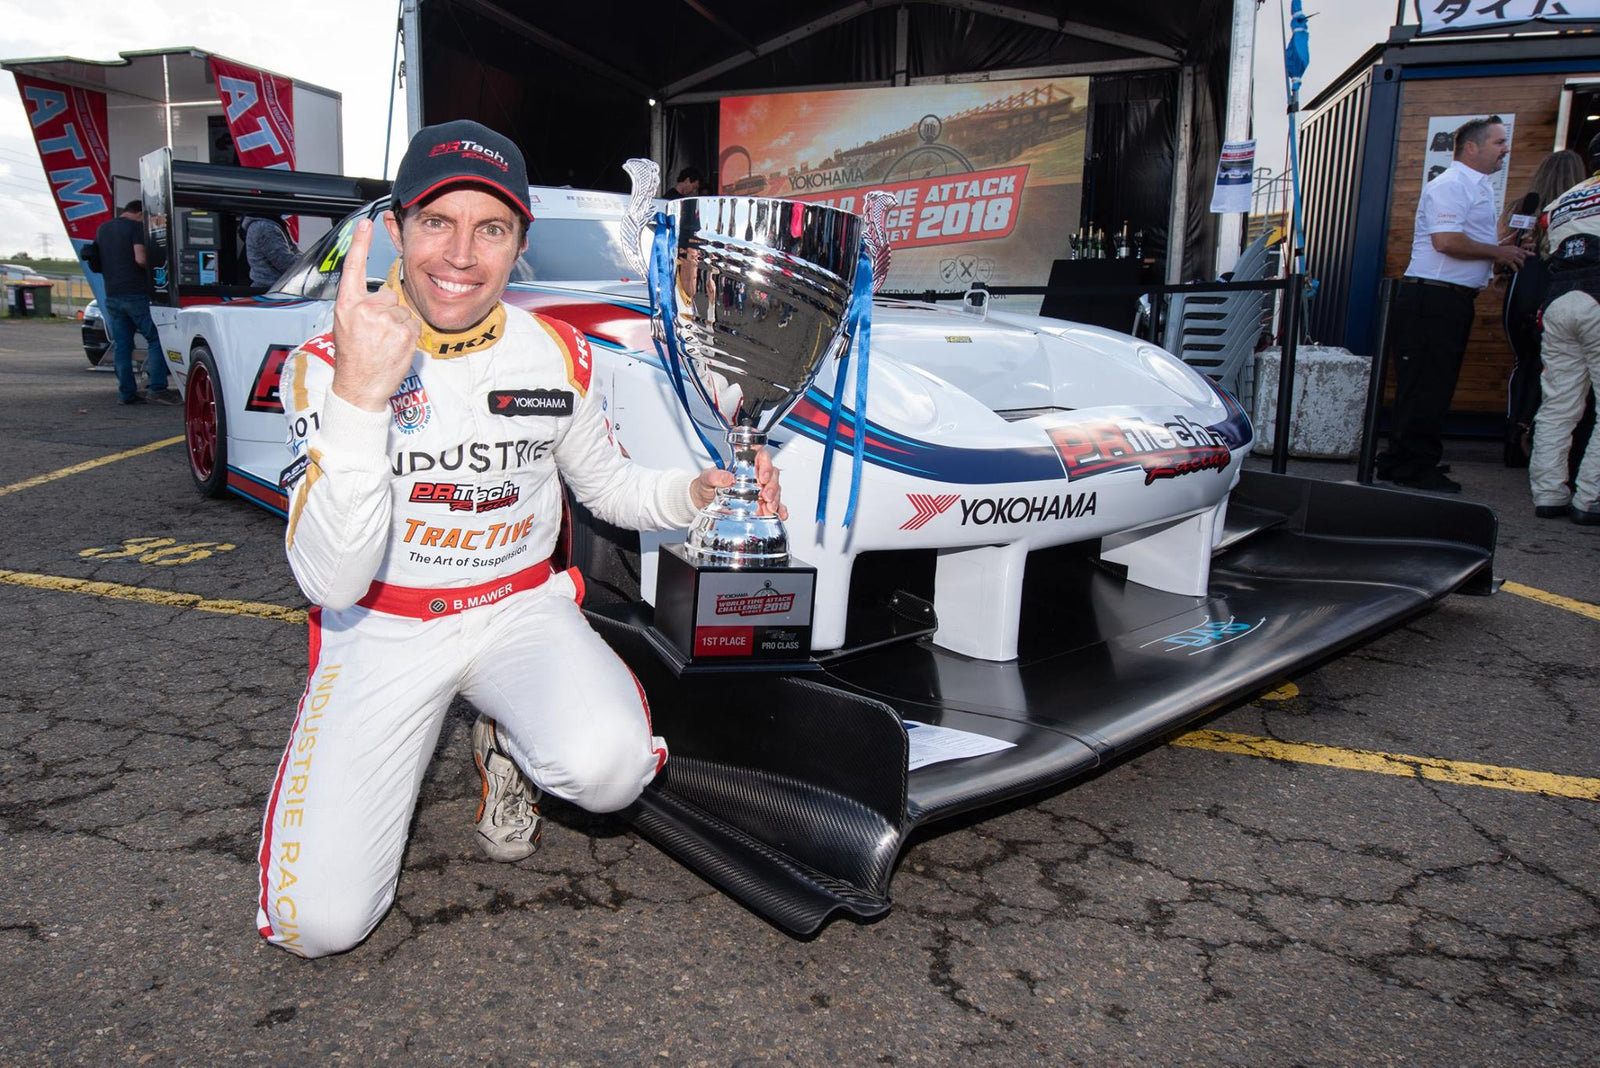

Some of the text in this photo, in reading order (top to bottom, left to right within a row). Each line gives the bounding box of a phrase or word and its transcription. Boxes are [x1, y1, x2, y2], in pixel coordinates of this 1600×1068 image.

[24, 85, 108, 222] ATM
[788, 167, 864, 191] YOKOHAMA
[923, 175, 1017, 203] ATTACK
[915, 197, 1013, 239] 2018
[392, 388, 426, 412] MOLY
[513, 397, 567, 408] YOKOHAMA
[960, 491, 1097, 526] YOKOHAMA
[408, 543, 528, 568] The Art of Suspension
[453, 583, 513, 610] B.MAWER
[702, 636, 746, 646] 1ST PLACE
[761, 641, 799, 650] PRO CLASS
[274, 664, 343, 948] INDUSTRIE RACIN
